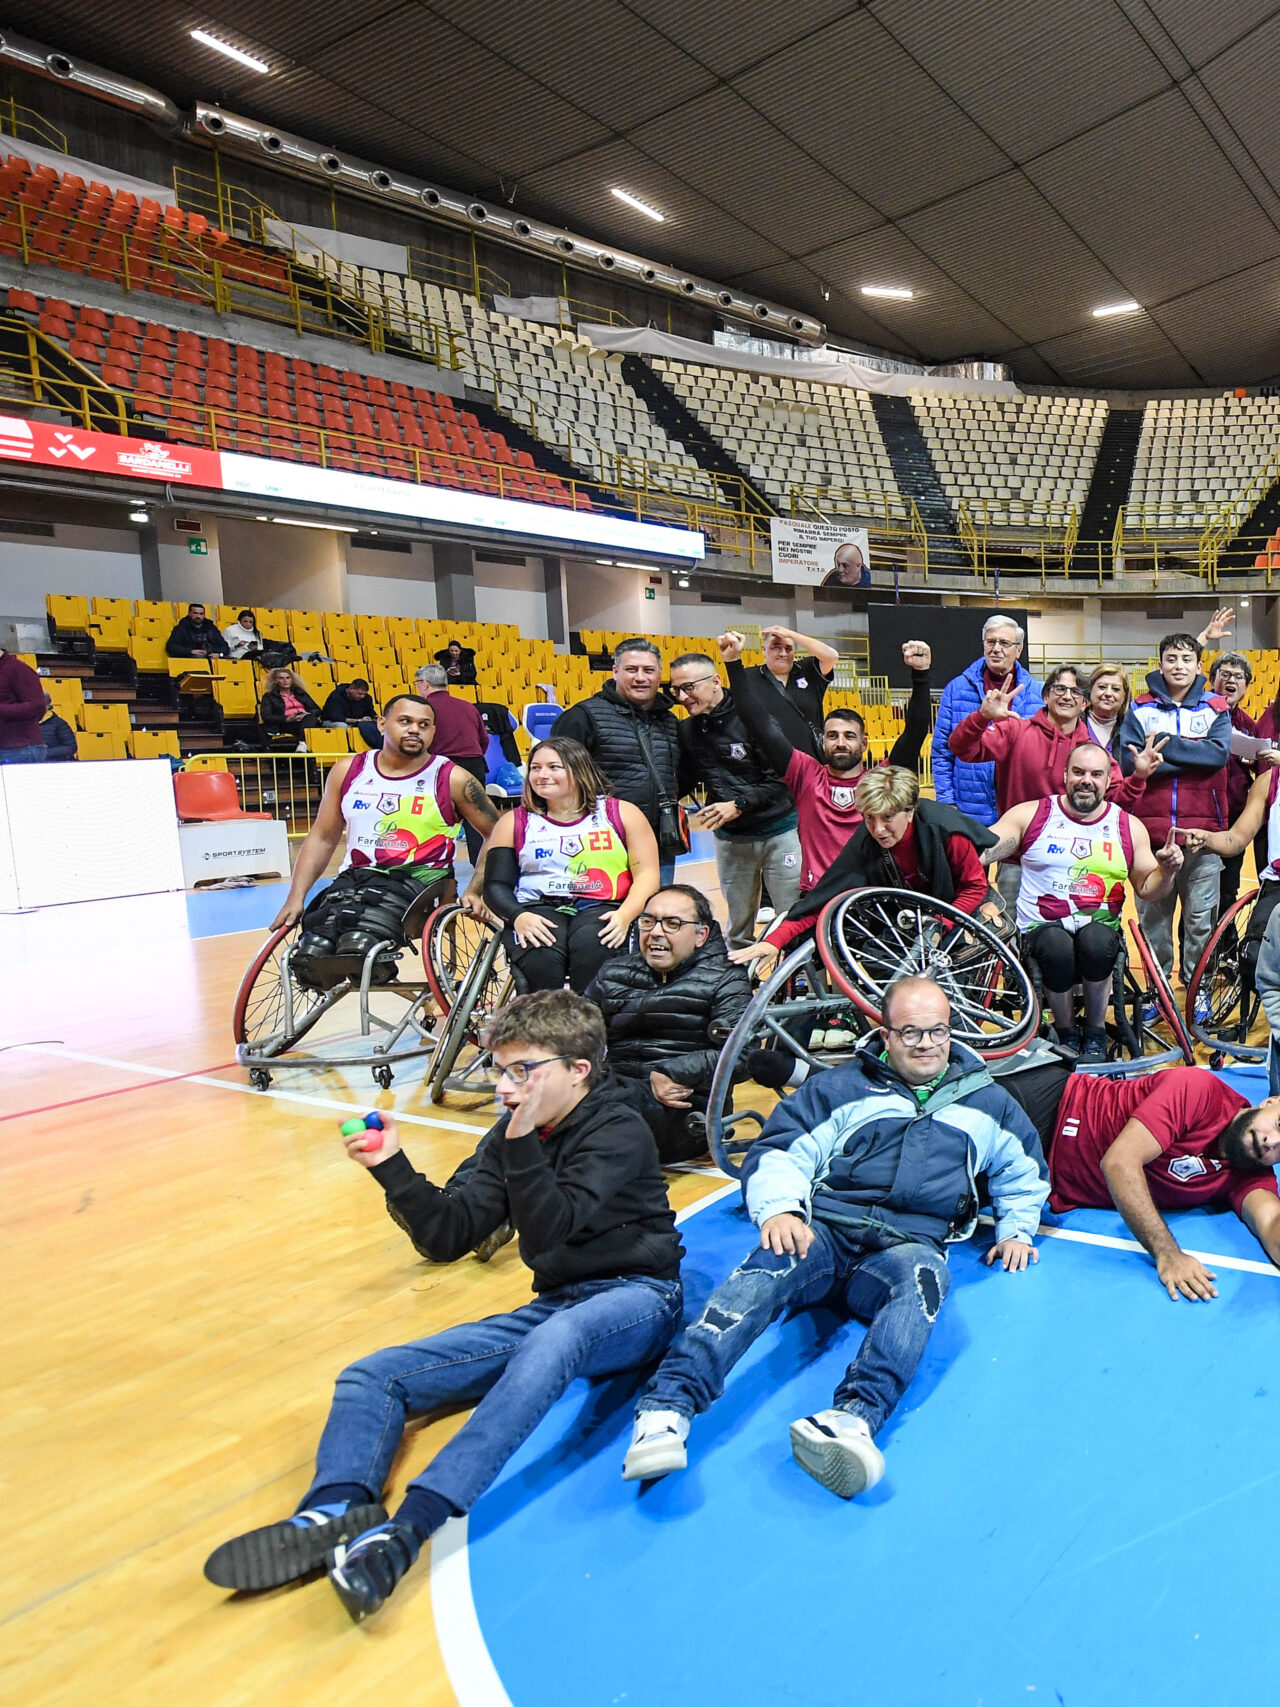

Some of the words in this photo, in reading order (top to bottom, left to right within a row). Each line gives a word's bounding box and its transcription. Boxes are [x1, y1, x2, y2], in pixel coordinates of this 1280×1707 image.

[779, 519, 812, 529] PASQUALE
[813, 524, 838, 532] QUESTO
[790, 547, 813, 555] NOSTRI
[792, 541, 817, 549] SEMPRE
[778, 558, 819, 567] IMPERATORE
[411, 795, 425, 815] 6
[588, 829, 613, 851] 23
[1102, 841, 1112, 862] 9
